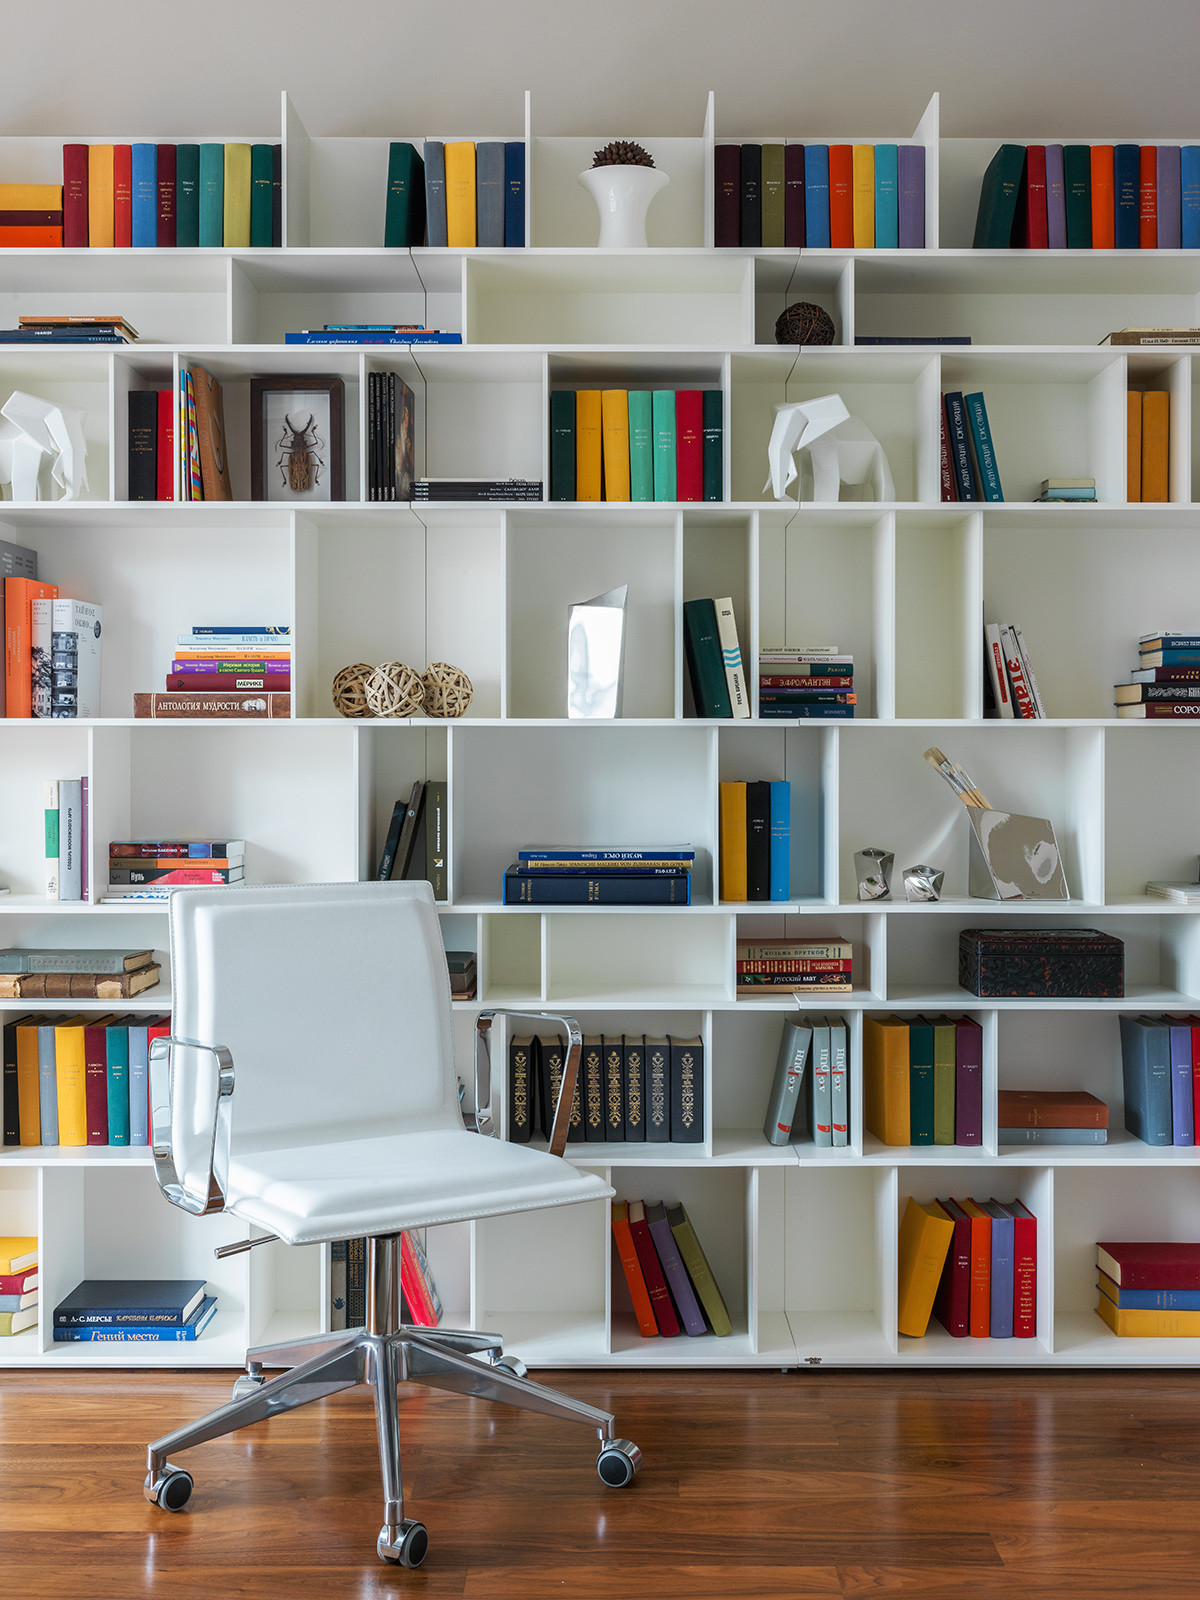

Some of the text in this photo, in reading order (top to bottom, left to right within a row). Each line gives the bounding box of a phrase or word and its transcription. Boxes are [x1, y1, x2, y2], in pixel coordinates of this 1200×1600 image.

[157, 702, 240, 711] АНТОЛОГИЯ МУДРОСТИ
[1173, 705, 1200, 714] СОРО
[130, 872, 145, 882] Нуль
[773, 973, 802, 984] русский
[787, 1049, 805, 1078] Грин
[815, 1048, 830, 1078] Грин
[832, 1048, 846, 1077] Грин
[149, 1314, 177, 1322] ПАРИЖА
[91, 1330, 160, 1341] Гений места
